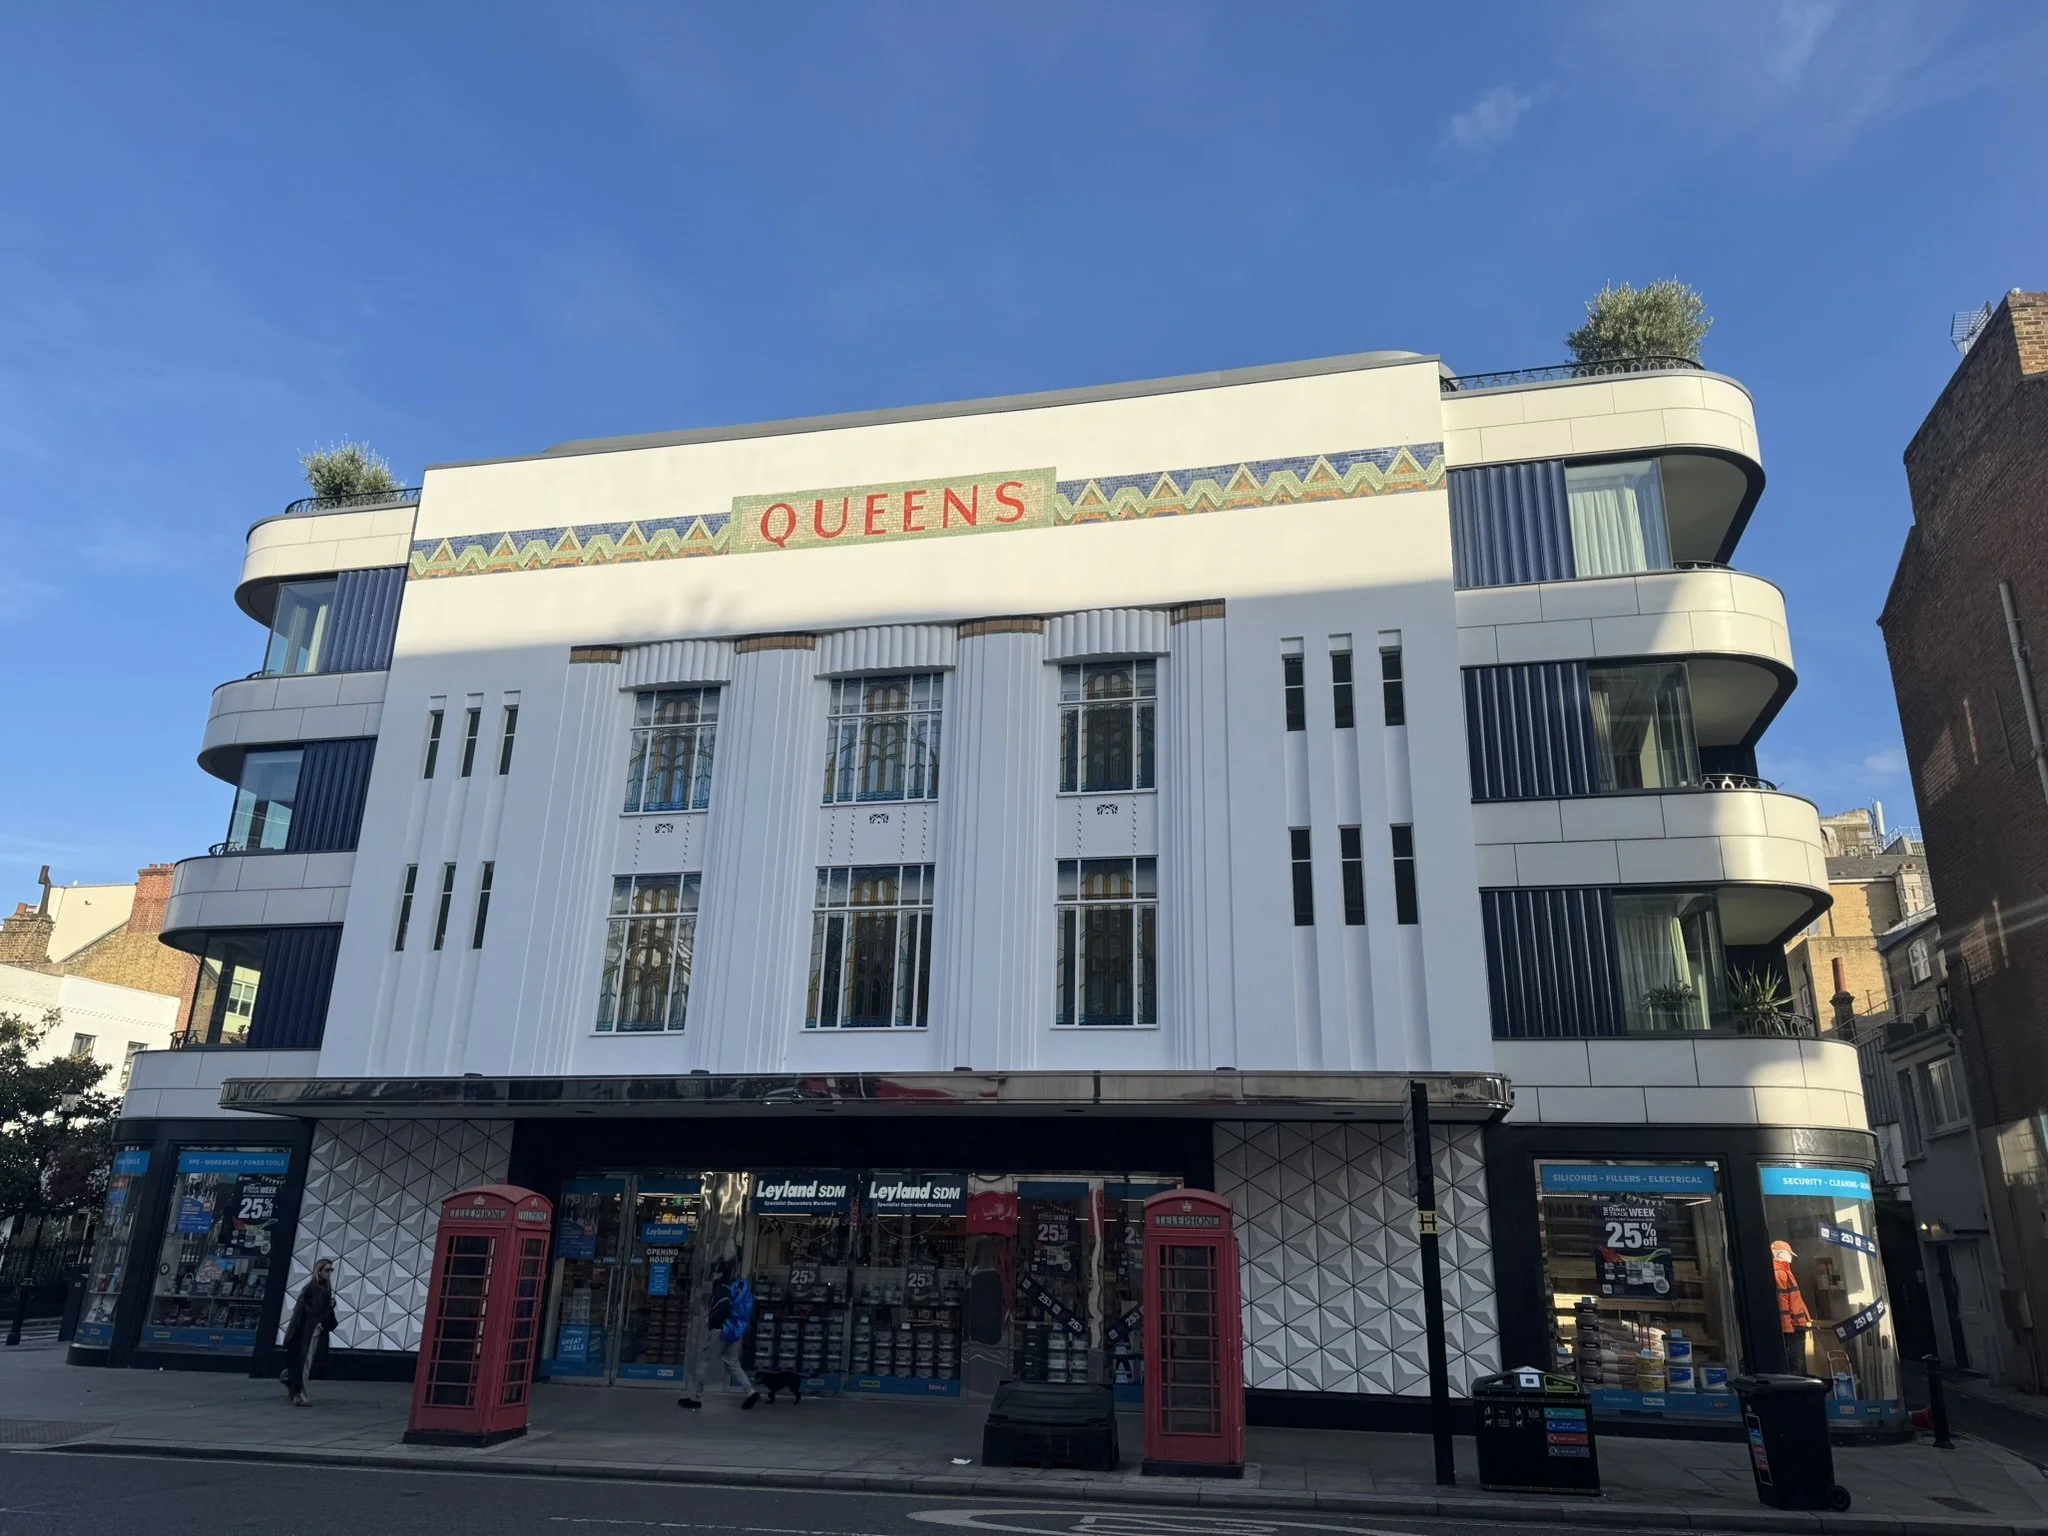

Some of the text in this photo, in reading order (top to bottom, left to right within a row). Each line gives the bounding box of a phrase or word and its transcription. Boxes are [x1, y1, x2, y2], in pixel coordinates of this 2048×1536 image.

[760, 481, 1025, 548] QUEENS
[1553, 1174, 1703, 1184] SILICONES FILLERS ELECTRICAL
[1782, 1177, 1823, 1185] SECURITY
[1829, 1179, 1858, 1189] CLEANING
[756, 1180, 847, 1201] Leyland SDM
[869, 1181, 961, 1202] Leyland SDM
[238, 1197, 274, 1219] 25%
[1629, 1208, 1656, 1217] WEEK
[1156, 1215, 1218, 1225] TELEPHONE
[1037, 1223, 1069, 1242] 25%
[1605, 1222, 1657, 1249] 25%
[1643, 1236, 1658, 1247] off
[646, 1248, 679, 1256] OPENING
[561, 1337, 582, 1346] GREAT
[564, 1343, 584, 1352] DEALS
